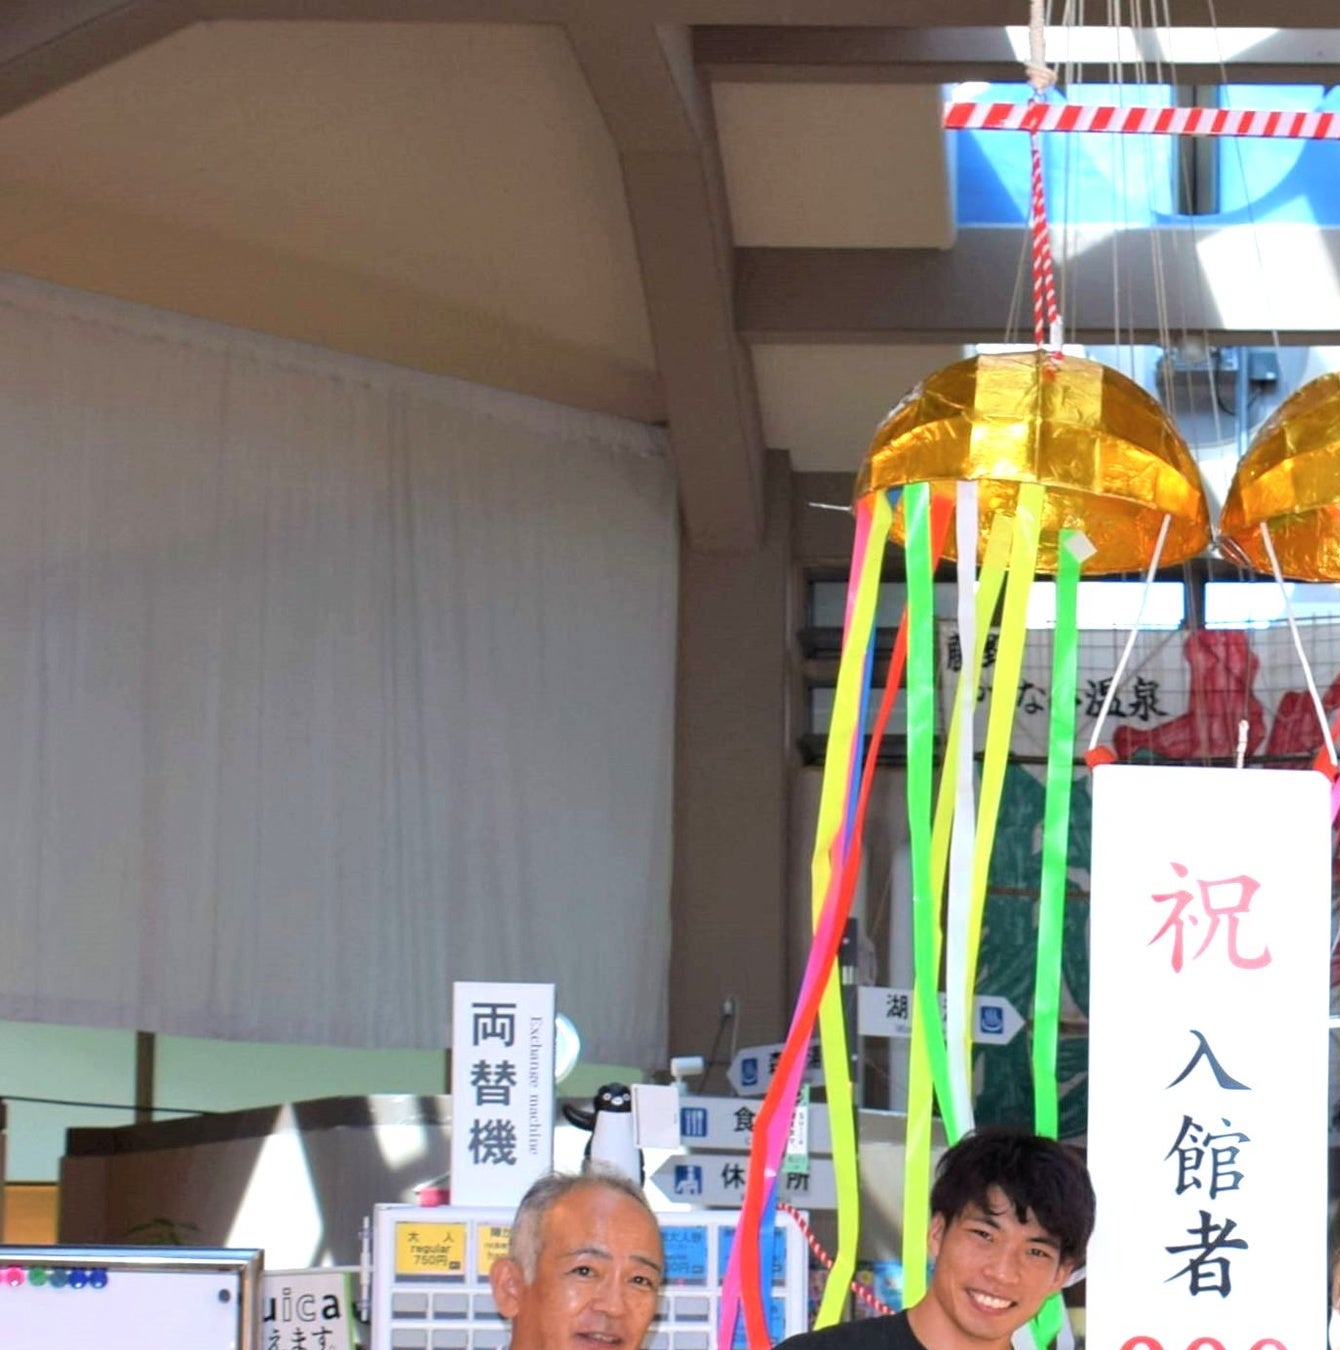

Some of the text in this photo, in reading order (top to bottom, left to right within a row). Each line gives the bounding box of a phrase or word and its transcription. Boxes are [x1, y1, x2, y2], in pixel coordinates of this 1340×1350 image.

[1147, 861, 1273, 974] 祝
[468, 1002, 518, 1166] 両替機
[528, 1016, 543, 1156] Exchange machine
[410, 1243, 452, 1254] regular
[412, 1254, 448, 1267] 750円
